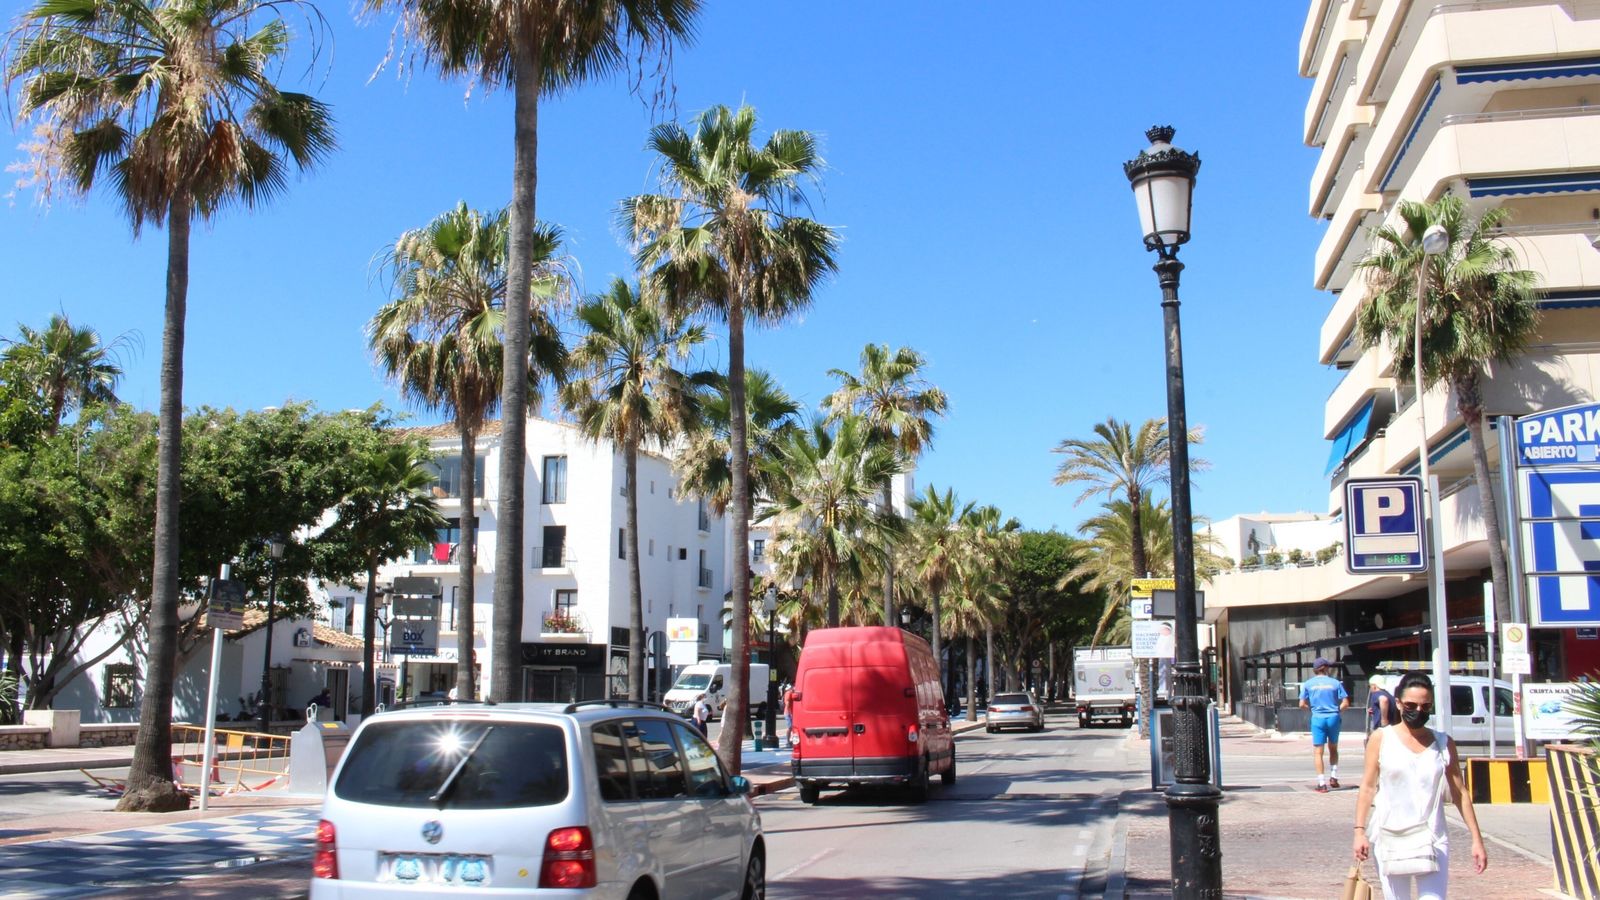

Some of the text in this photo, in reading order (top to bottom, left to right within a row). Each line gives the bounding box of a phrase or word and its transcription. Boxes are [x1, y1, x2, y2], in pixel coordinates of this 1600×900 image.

[1523, 445, 1576, 459] ABIERTO
[1363, 487, 1406, 534] P
[555, 648, 586, 656] BRAND
